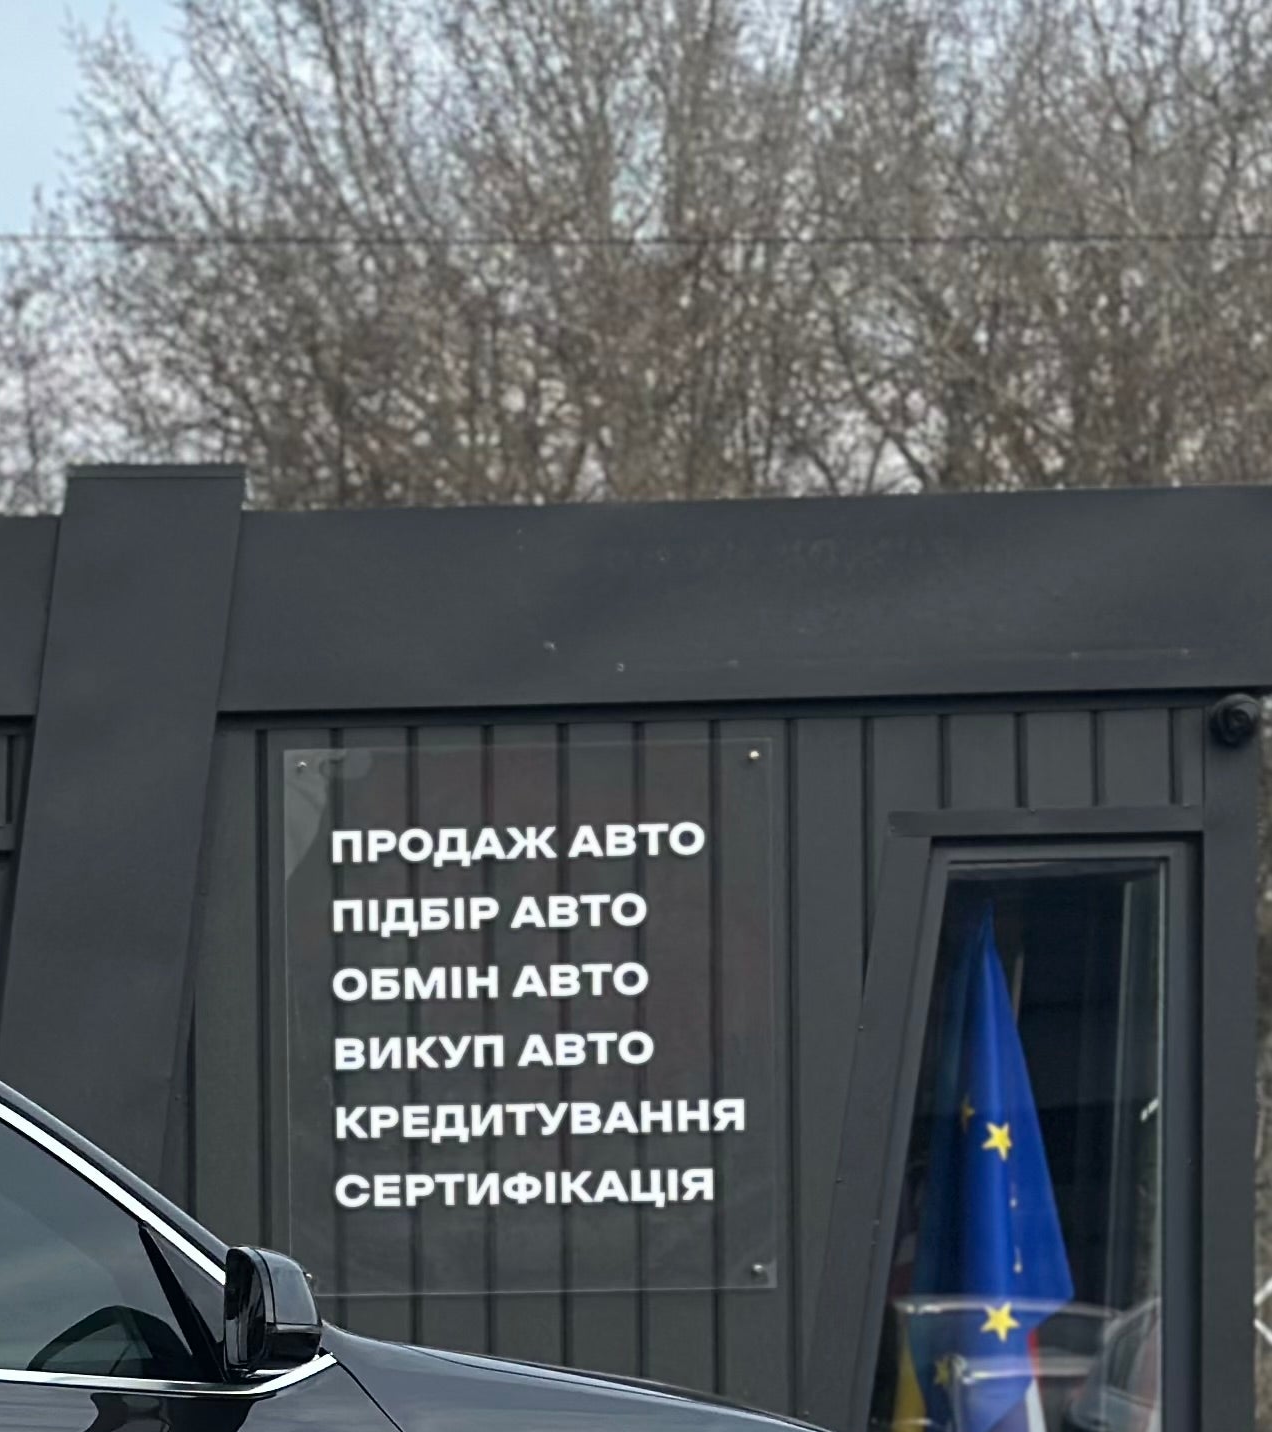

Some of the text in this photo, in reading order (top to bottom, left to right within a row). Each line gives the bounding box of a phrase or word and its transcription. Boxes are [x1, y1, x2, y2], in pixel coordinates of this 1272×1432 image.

[333, 822, 705, 867] ПРОДАЖ АВТО
[333, 893, 647, 937] ПІДБІР АВТО
[333, 962, 648, 1001] ОБМІН АВТО
[335, 1031, 654, 1070] ВИКУП АВТО
[336, 1099, 744, 1143] КРЕДИТУВАННЯ
[335, 1168, 713, 1207] СЕРТИФІКАЦІЯ
